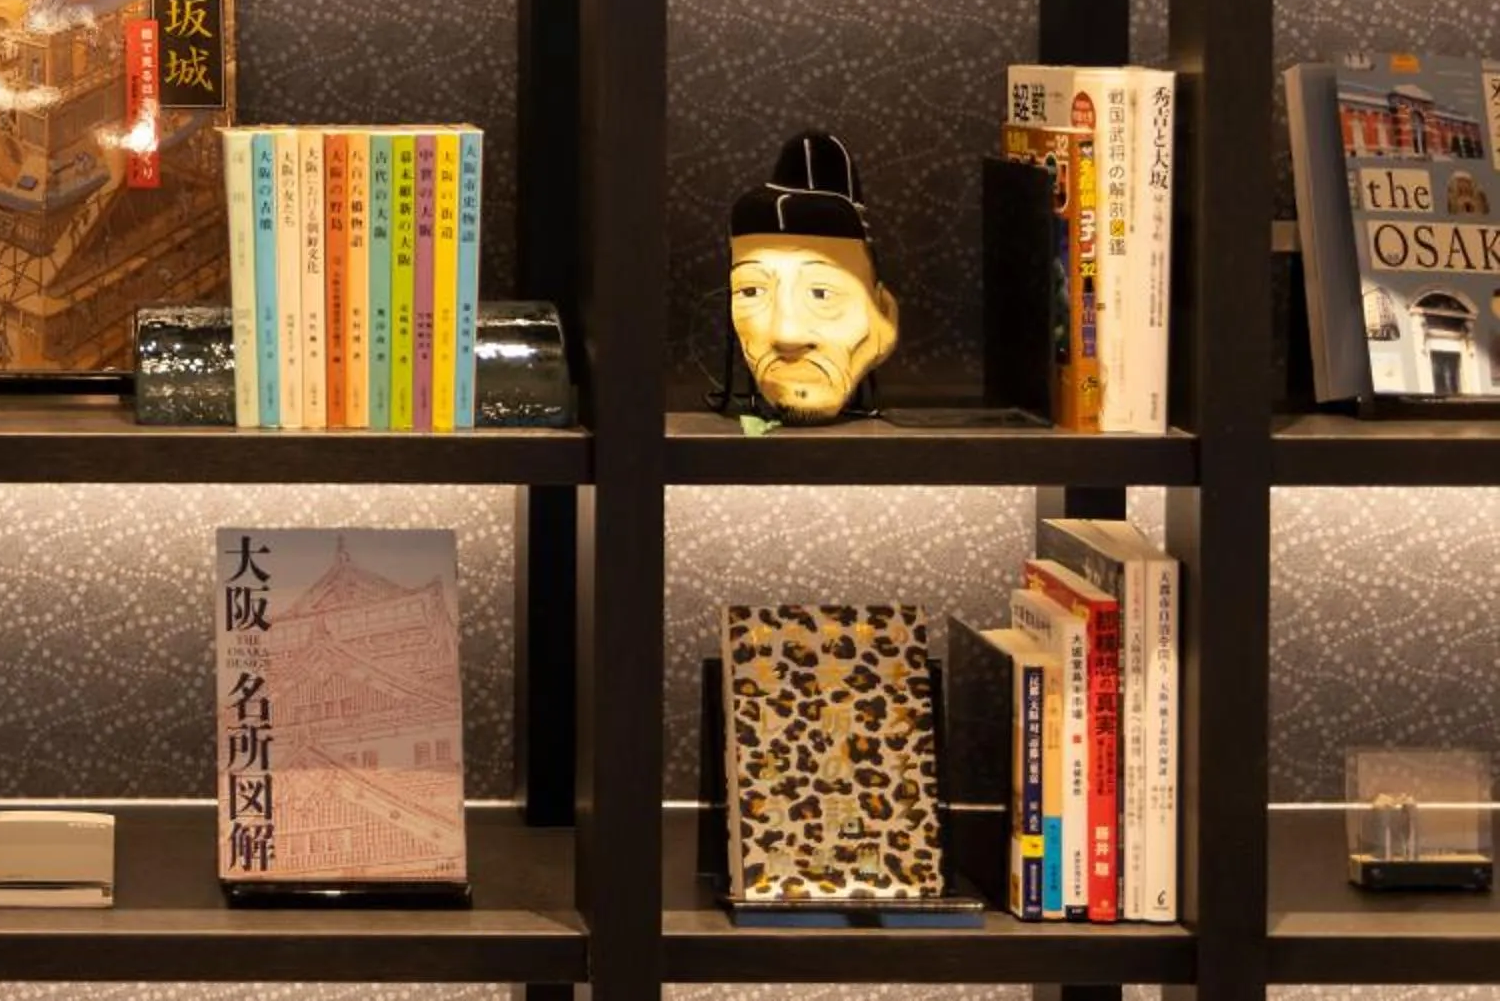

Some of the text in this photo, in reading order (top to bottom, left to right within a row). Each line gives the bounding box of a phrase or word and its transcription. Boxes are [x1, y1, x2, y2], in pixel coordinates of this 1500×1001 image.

[1108, 88, 1126, 256] 戦国武将の解剖図鑑
[1366, 172, 1430, 211] the
[227, 672, 276, 872] 名所図解
